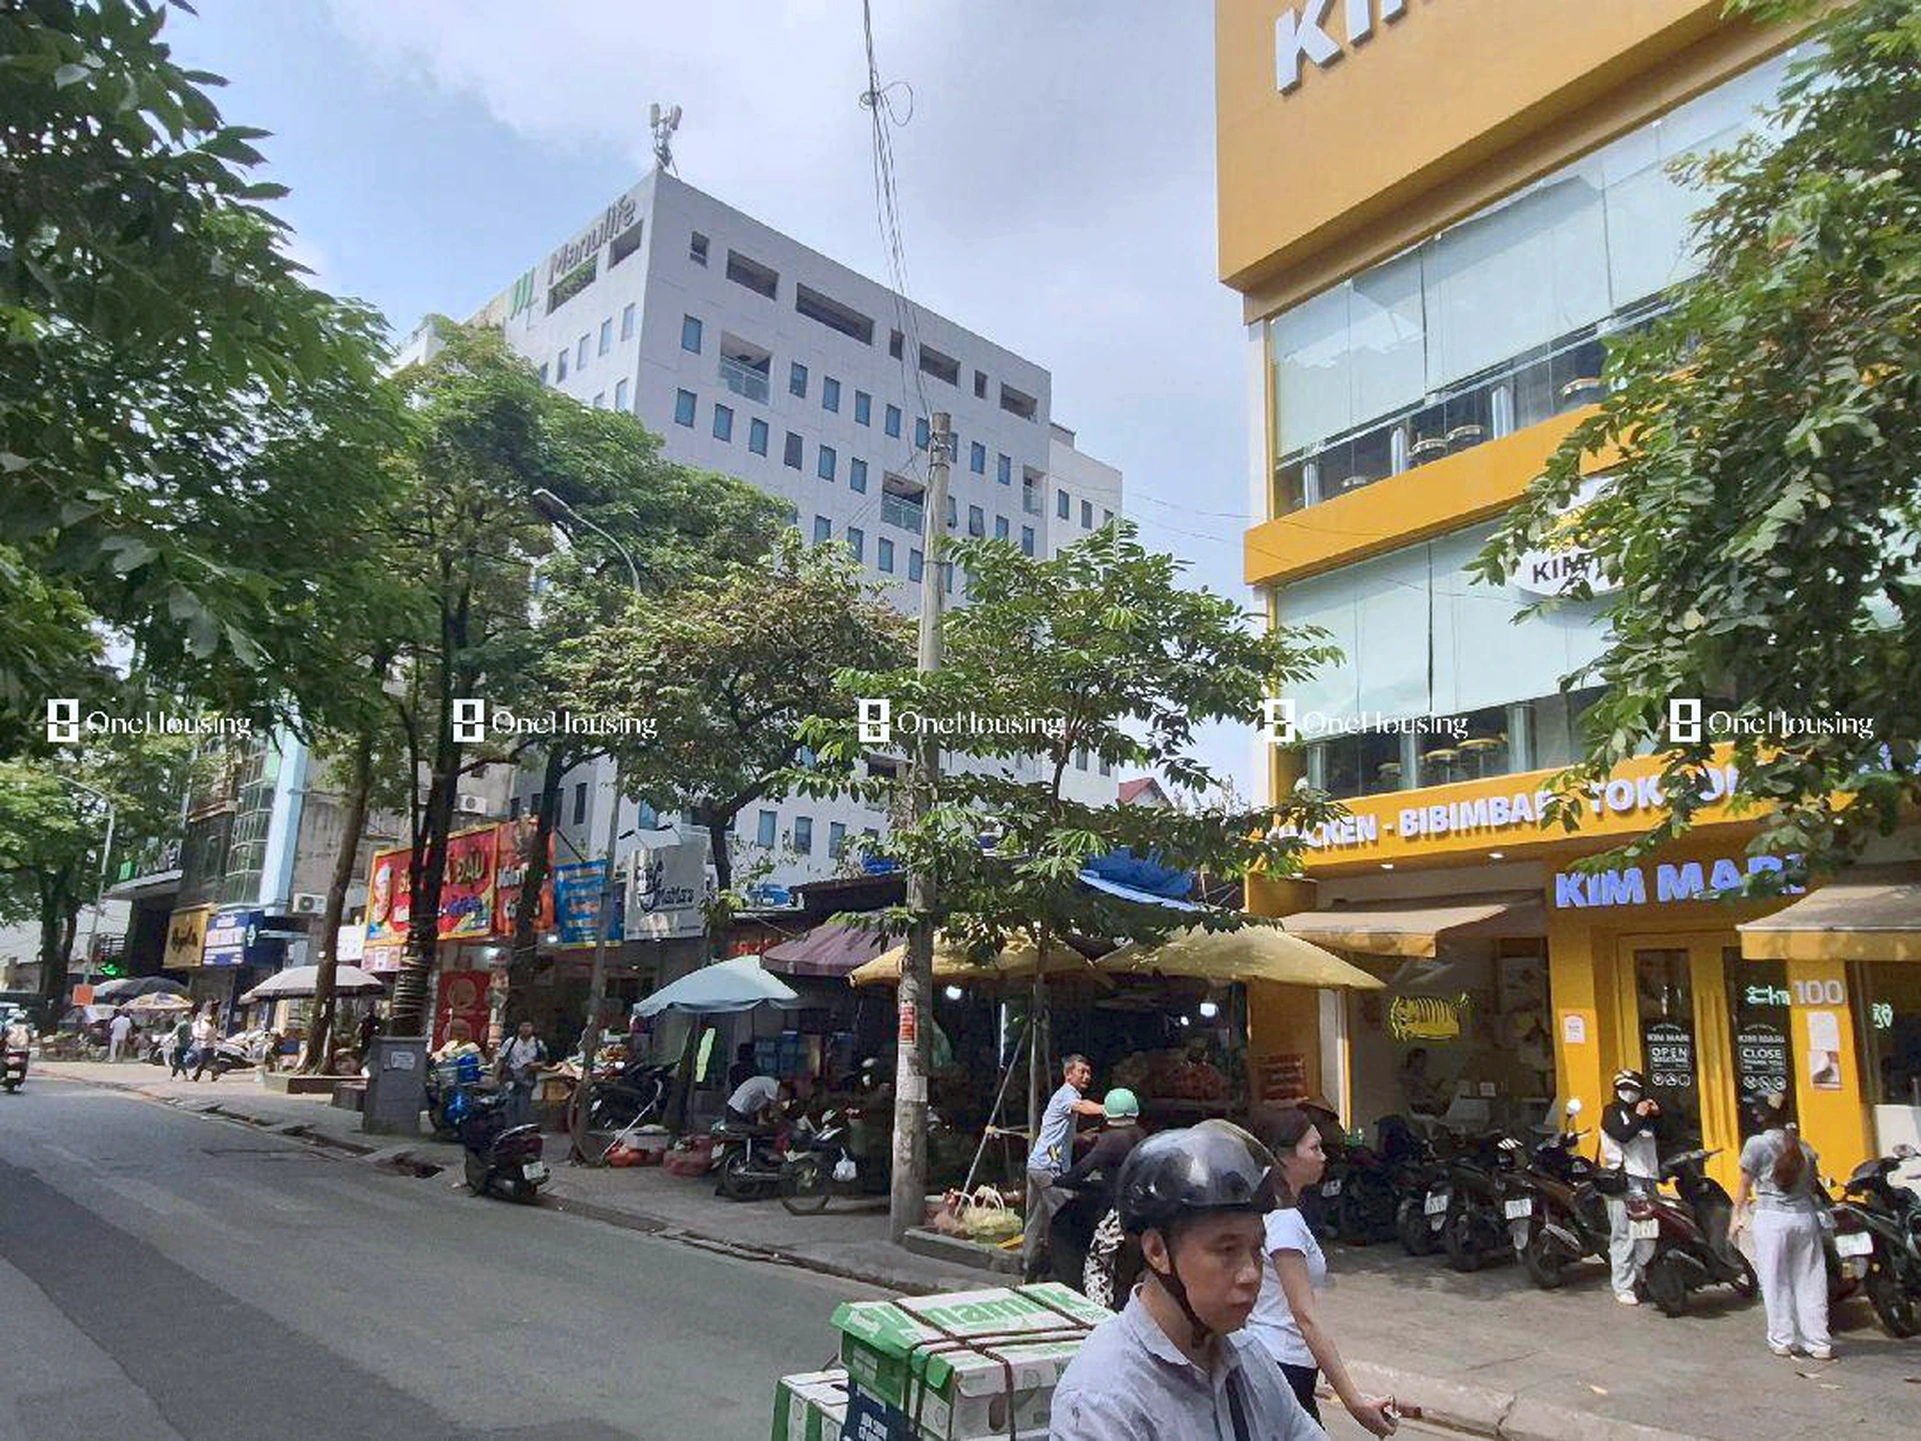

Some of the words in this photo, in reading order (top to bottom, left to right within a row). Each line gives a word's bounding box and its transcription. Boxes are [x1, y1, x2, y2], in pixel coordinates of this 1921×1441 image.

[1275, 0, 1410, 95] KI
[547, 194, 637, 286] Manulife
[1555, 868, 1646, 908] KIM
[1793, 979, 1844, 1005] 100
[1651, 1047, 1688, 1058] OPEN
[1742, 1048, 1783, 1059] CLOSE
